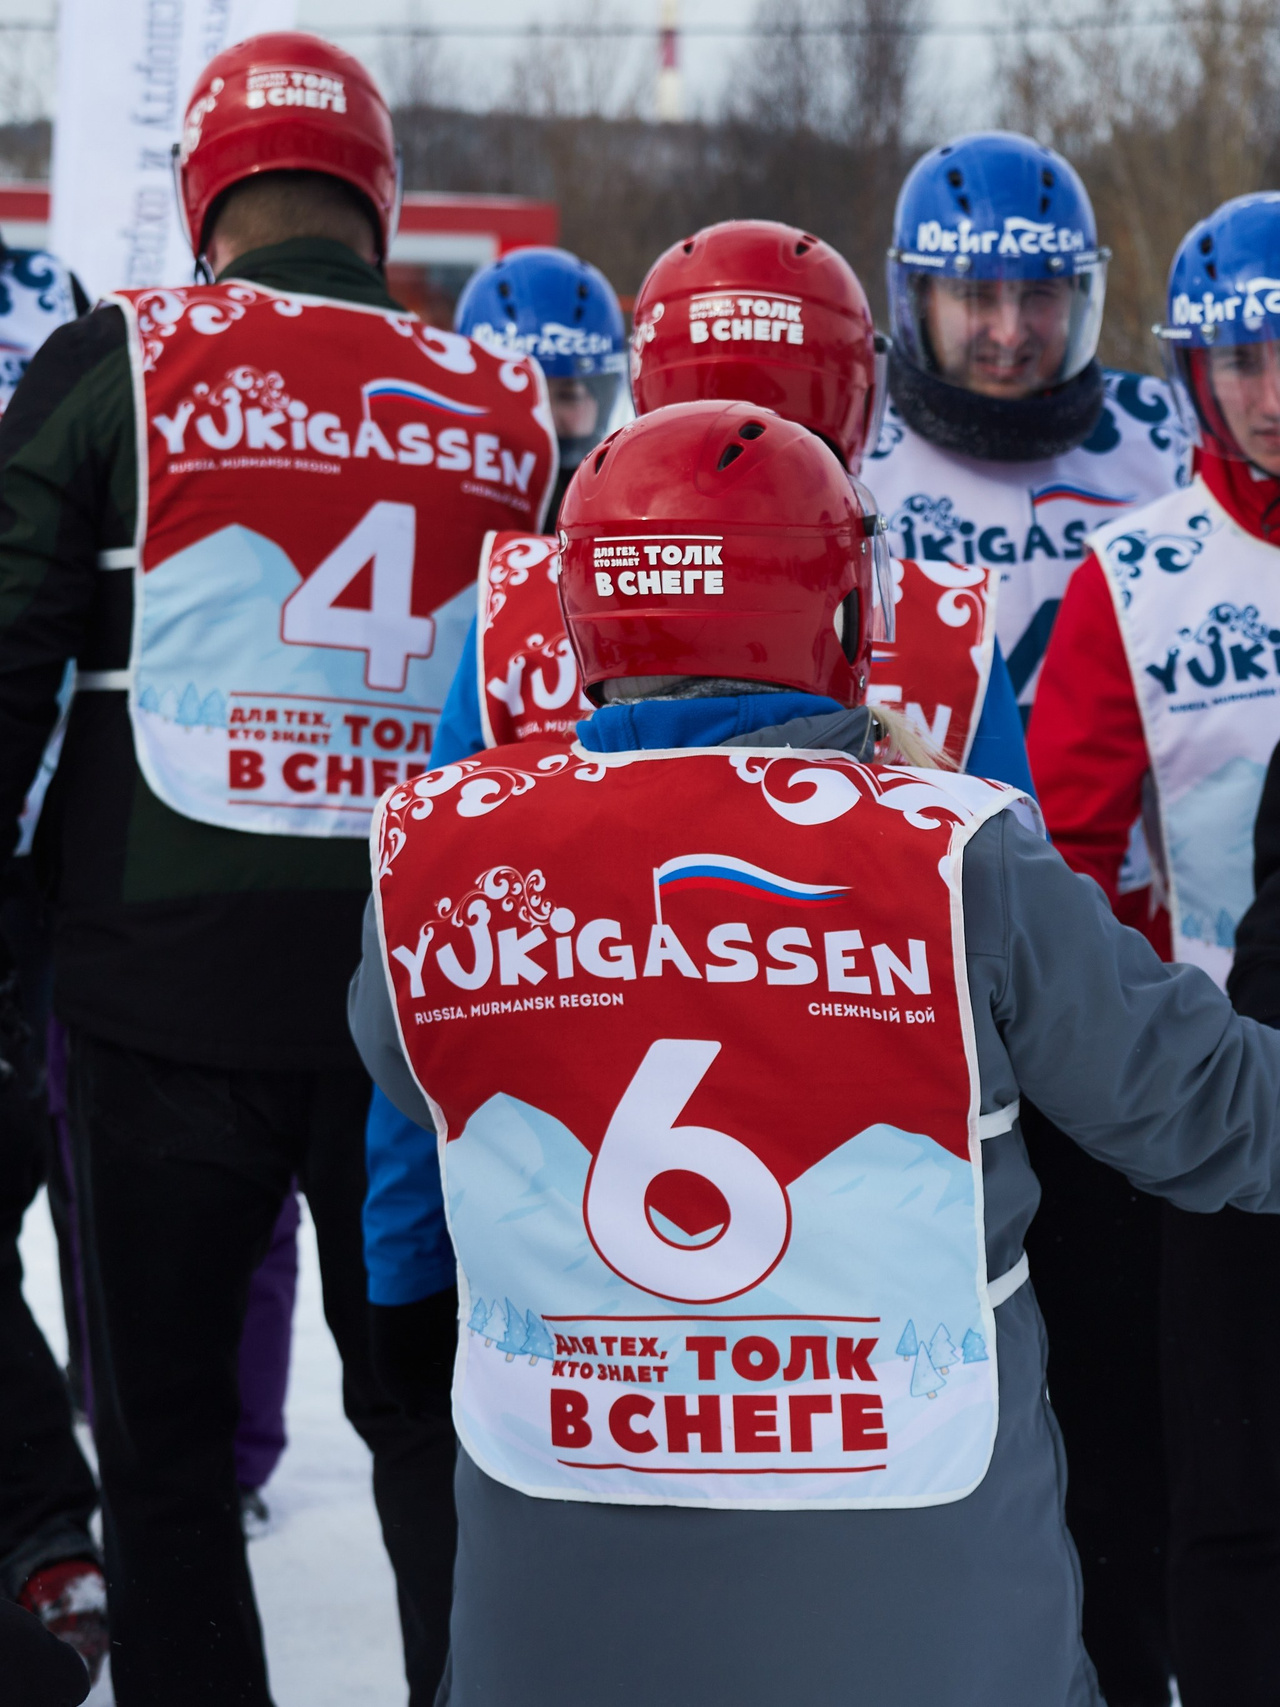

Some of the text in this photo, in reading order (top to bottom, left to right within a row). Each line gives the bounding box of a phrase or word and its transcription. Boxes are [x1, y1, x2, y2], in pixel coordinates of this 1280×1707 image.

[267, 86, 347, 114] СНЕГЕ
[737, 298, 802, 322] ТОЛК
[690, 318, 804, 345] В СНЕГЕ
[594, 547, 614, 559] ДЛЯ
[644, 545, 723, 566] ТОЛК
[281, 499, 436, 693] 4
[595, 570, 724, 597] В СНЕГЕ
[230, 708, 331, 728] ДЛЯ ТЕХ,
[228, 729, 331, 745] КТО ЗНАЕТ
[344, 714, 433, 754] ТОЛ
[229, 749, 265, 791] В
[415, 992, 624, 1026] RUSSIA, MURMANSK REGION
[808, 1002, 936, 1024] СНЕЖНЫЙ БОЙ
[582, 1037, 793, 1305] 6
[554, 1333, 668, 1360] ДЛЯ ТЕХ,
[686, 1335, 880, 1382] ТОЛК
[552, 1360, 669, 1383] КТО ЗНАЕТ
[550, 1388, 888, 1454] В СНЕГЕ
